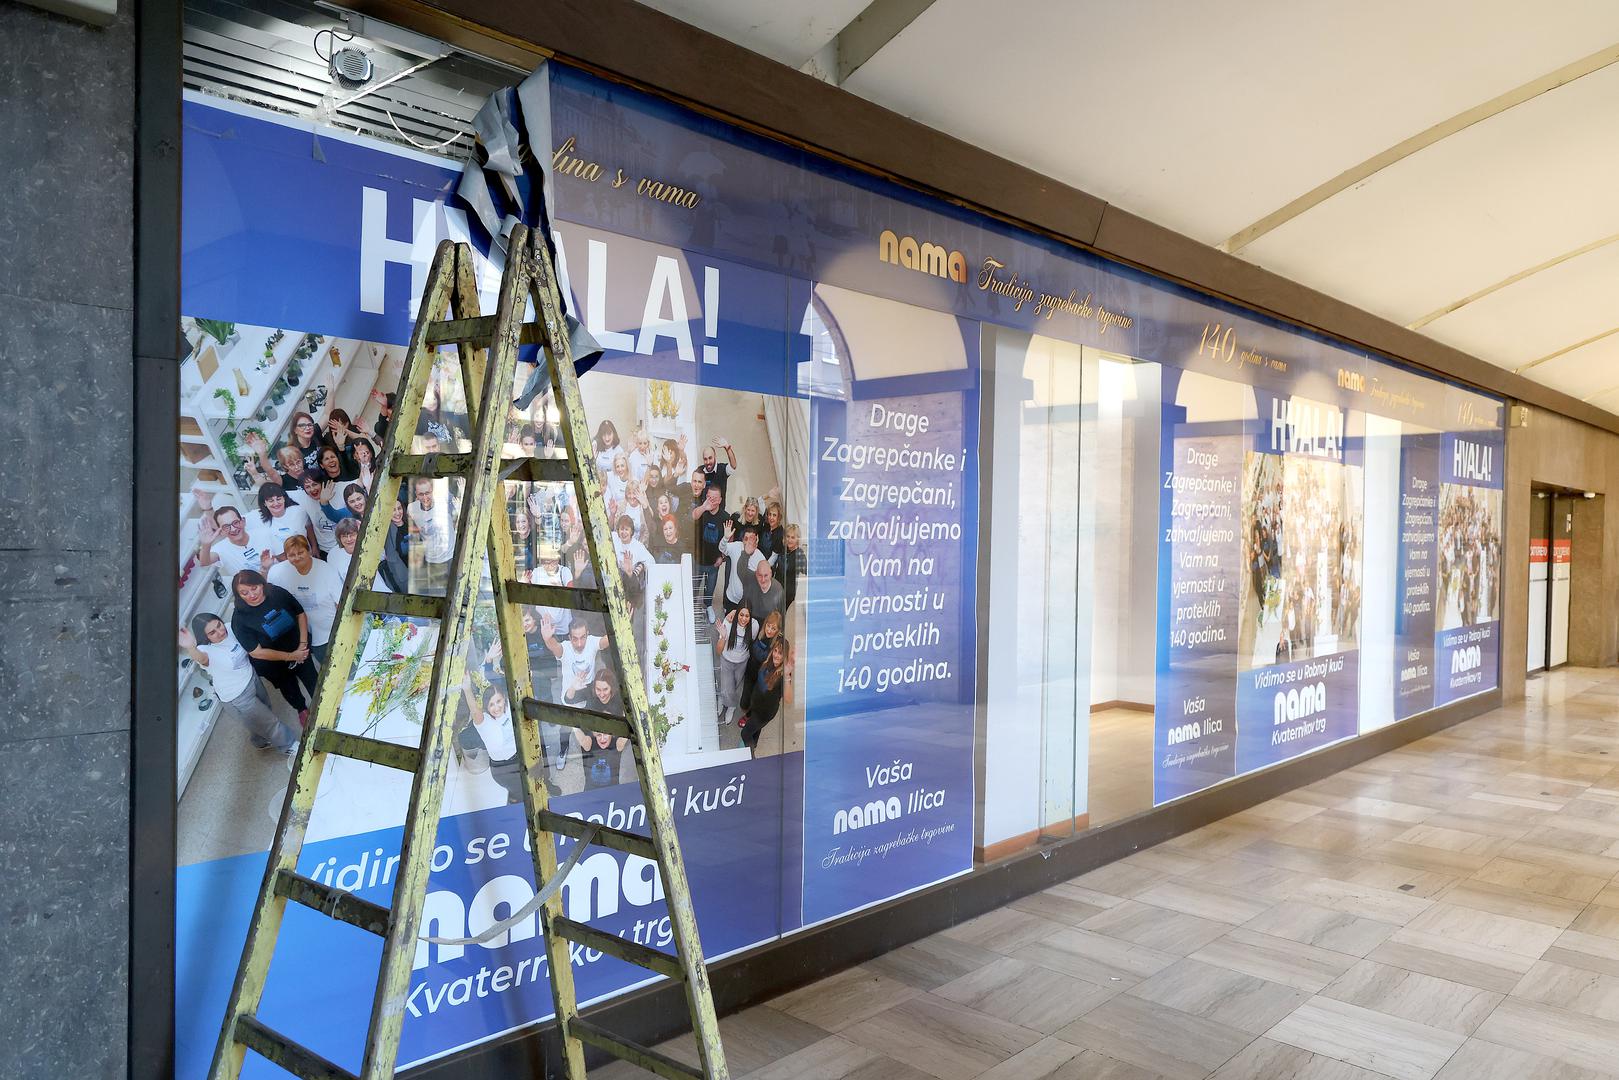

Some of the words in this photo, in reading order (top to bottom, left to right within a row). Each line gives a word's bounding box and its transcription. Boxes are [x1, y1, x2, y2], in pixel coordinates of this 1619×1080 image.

[611, 168, 629, 188] s
[637, 177, 700, 209] vama
[880, 229, 968, 284] nama
[977, 256, 1034, 312] Tradicija
[1096, 302, 1136, 334] trgovine
[1200, 323, 1237, 363] 140
[870, 403, 929, 437] Drage
[1272, 397, 1344, 460] HVALA!
[822, 437, 956, 472] Zagrepčanke
[960, 449, 966, 472] i
[1187, 448, 1218, 470] Drage
[1454, 439, 1492, 481] HVALA!
[840, 477, 956, 508] Zagrepčani,
[1164, 472, 1232, 495] Zagrepčanke
[1234, 476, 1237, 492] i
[1171, 500, 1232, 520] Zagrepčani,
[828, 515, 961, 546] zahvaljujemo
[1165, 525, 1234, 546] zahvaljujemo
[859, 554, 901, 577] Vam
[908, 557, 934, 576] na
[1180, 552, 1202, 568] Vam
[1204, 555, 1218, 566] na
[1173, 576, 1216, 598] vjernosti
[1218, 579, 1224, 592] u
[844, 587, 928, 621] vjernosti
[932, 592, 944, 610] u
[1176, 600, 1220, 624] proteklih
[850, 622, 940, 659] proteklih
[1170, 630, 1186, 648] 140
[1188, 625, 1226, 648] godina.
[1255, 670, 1284, 689] Vidimo
[1286, 670, 1296, 682] se
[1298, 668, 1302, 680] u
[1304, 658, 1328, 678] Robnoj
[1328, 656, 1344, 672] kući
[1452, 645, 1481, 674] nama
[838, 666, 870, 692] 140
[876, 660, 952, 692] godina.
[1184, 696, 1206, 715] Vaša
[1274, 682, 1326, 725] nama
[1168, 722, 1200, 746] nama
[1204, 718, 1222, 735] Ilica
[1272, 721, 1314, 746] Kvaternikov
[1316, 718, 1326, 732] trg
[866, 759, 912, 788] Vaša
[464, 832, 509, 866] se
[684, 774, 746, 817] kući
[834, 796, 902, 835] nama
[908, 788, 946, 814] Ilica
[822, 845, 872, 869] Tradicija
